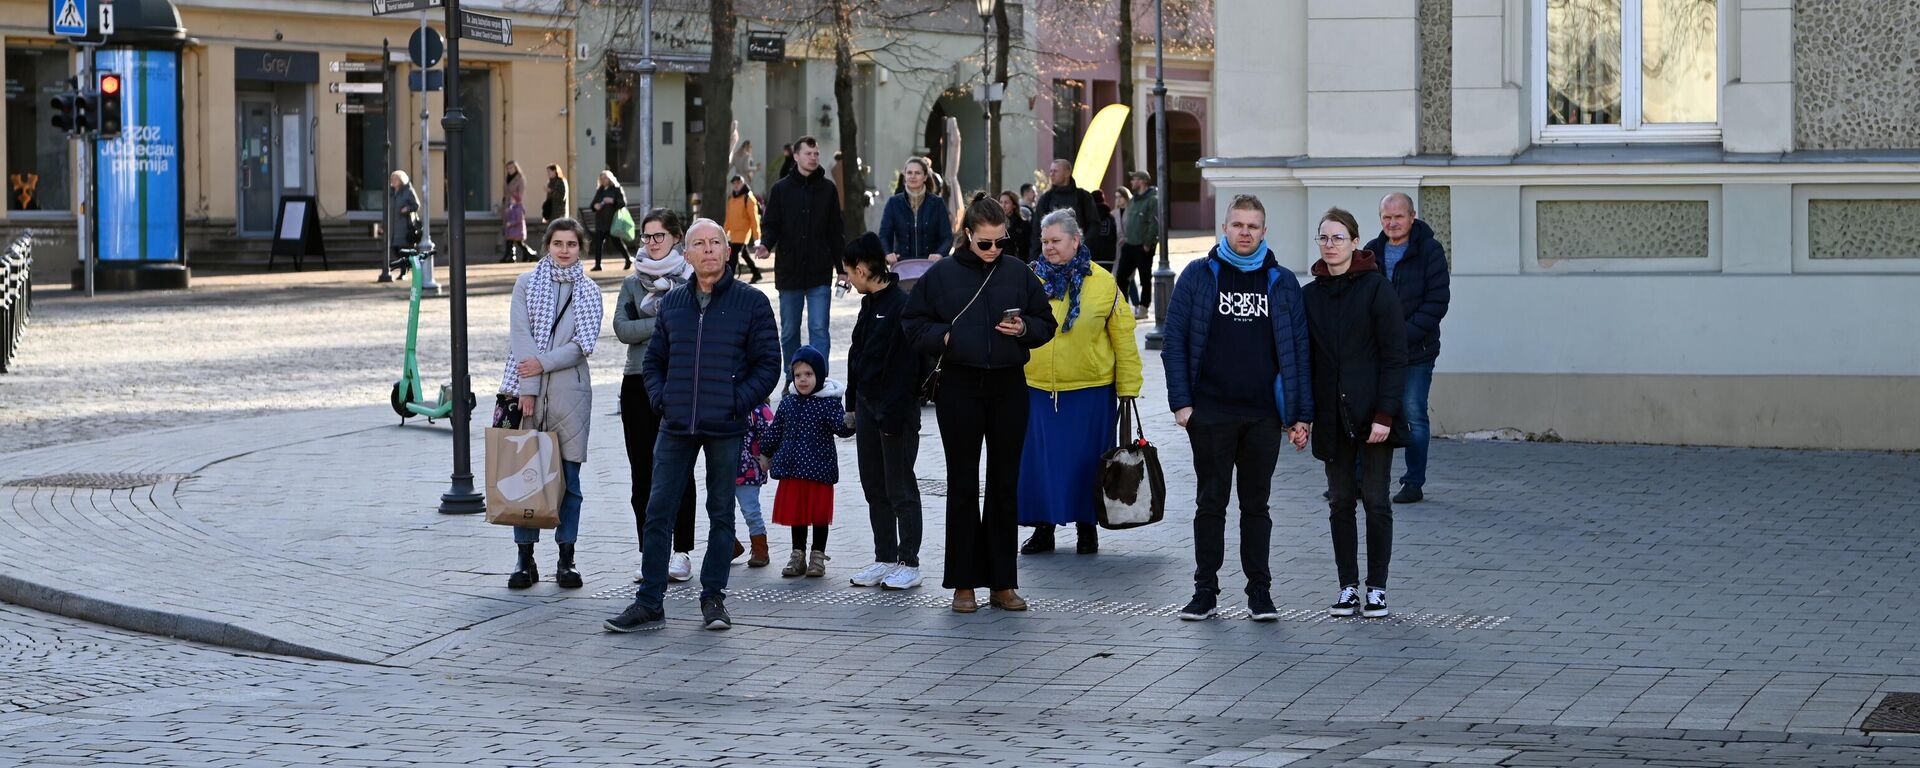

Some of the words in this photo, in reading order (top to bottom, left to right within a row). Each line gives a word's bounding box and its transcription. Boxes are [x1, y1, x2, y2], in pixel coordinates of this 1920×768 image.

[262, 52, 292, 77] Grey
[101, 140, 175, 157] JCDecaux
[112, 157, 169, 175] premija
[1219, 291, 1268, 305] NORTH
[1218, 302, 1269, 317] OCEAN
